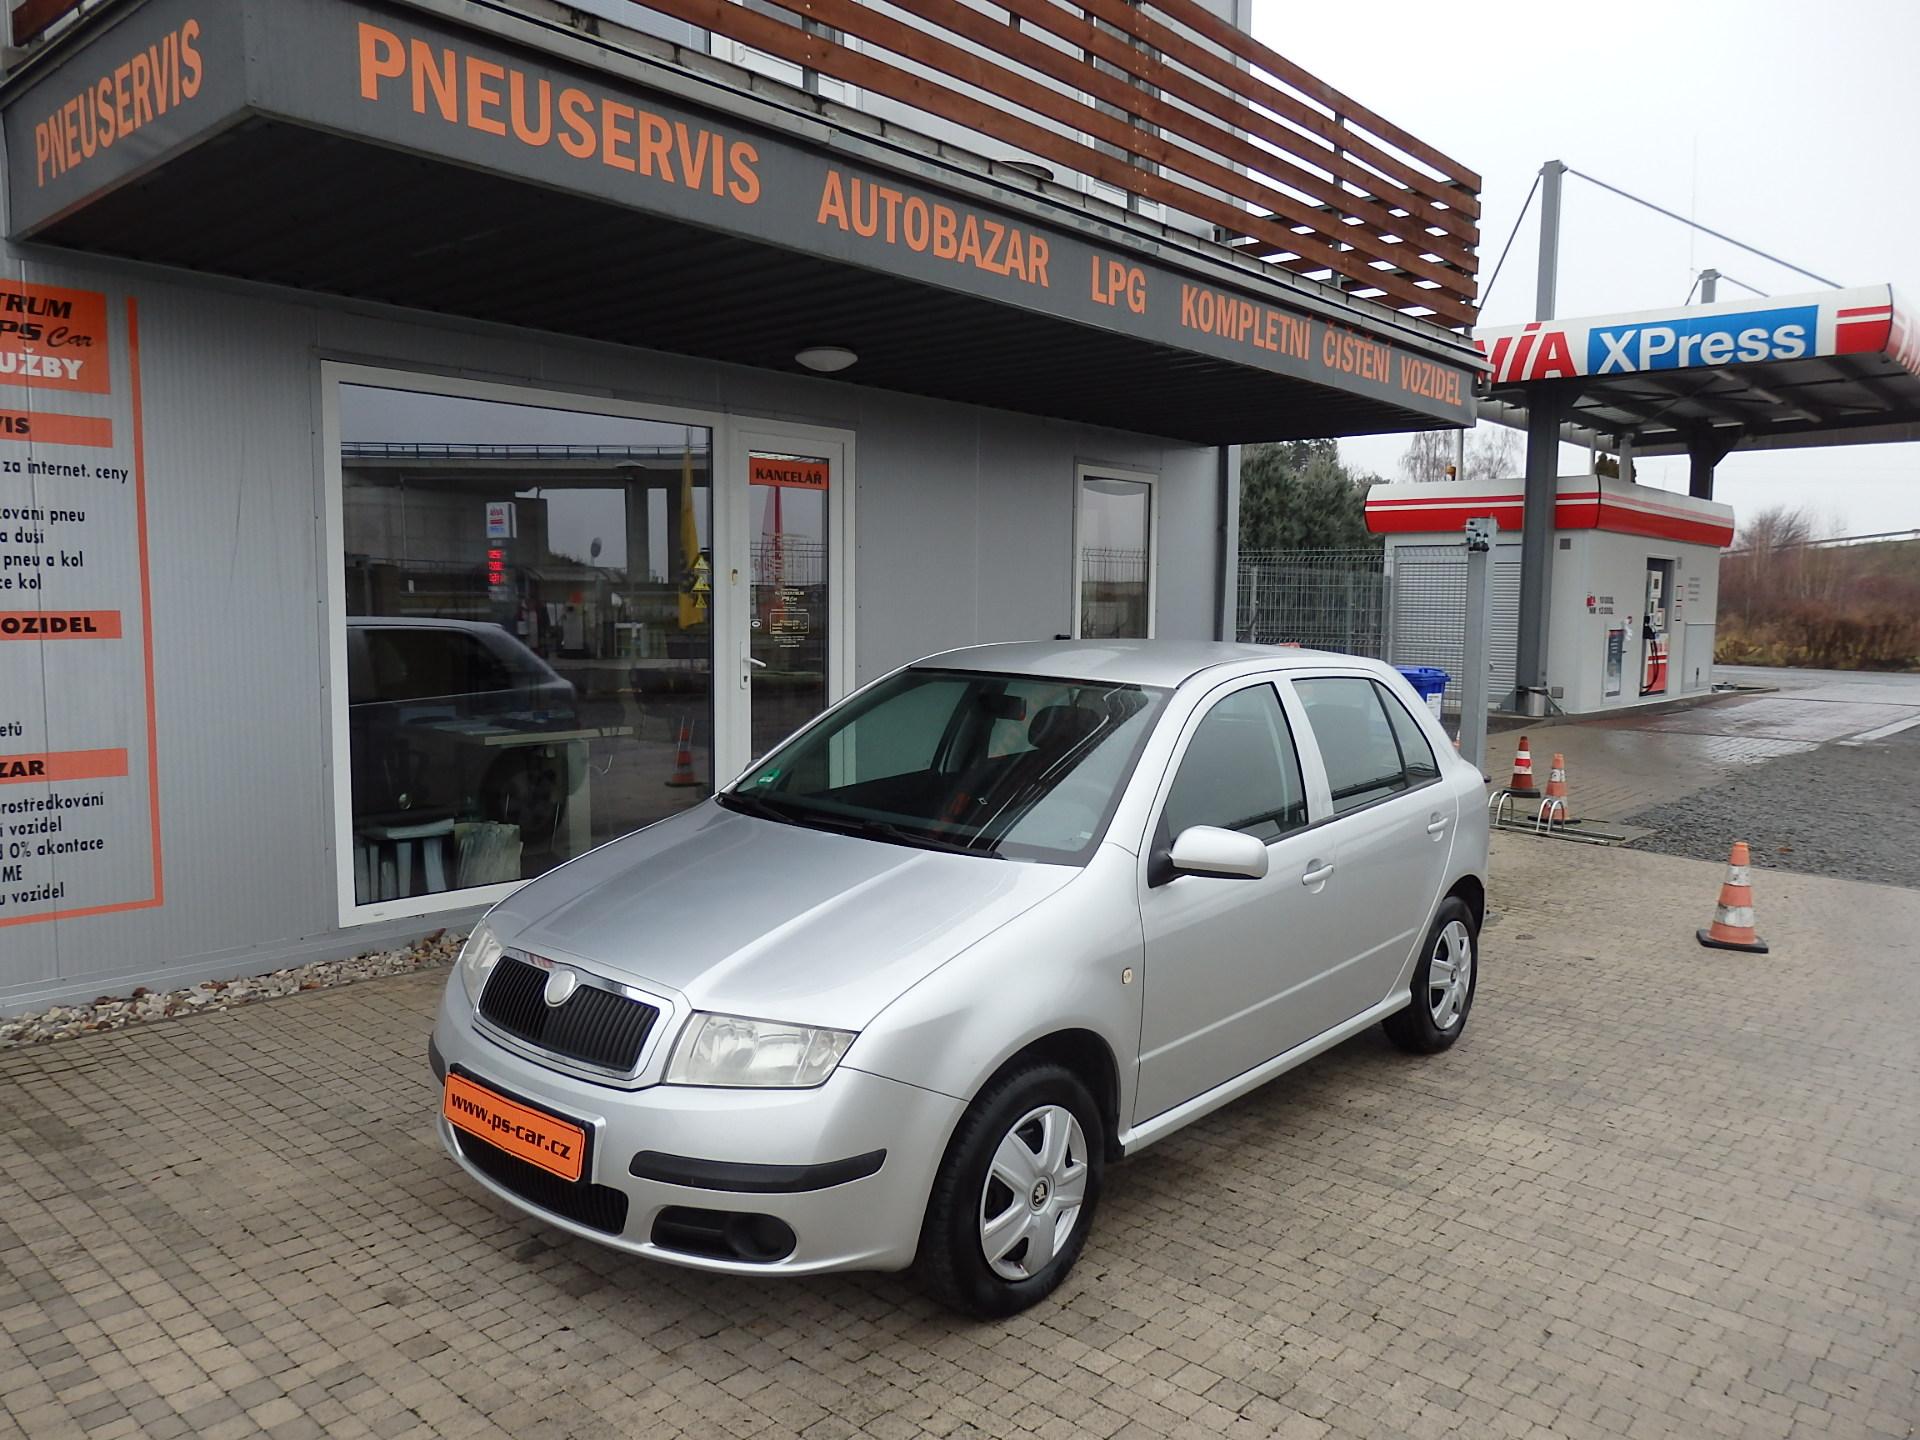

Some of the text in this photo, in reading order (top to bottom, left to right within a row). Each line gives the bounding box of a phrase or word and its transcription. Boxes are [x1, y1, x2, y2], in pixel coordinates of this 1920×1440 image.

[35, 18, 203, 188] PNEUSERVIS
[358, 22, 1463, 406] PNEUSERVIS AUTOBAZAR LPG KOMPLETNÍ ČIŠTĚNÍ VOZIDEL
[46, 326, 92, 347] Car
[0, 348, 84, 380] UŽBY
[1473, 323, 1808, 385] VIA XPress
[0, 415, 30, 434] IS
[3, 457, 129, 484] za internet. ceny
[755, 467, 823, 484] KANCELÁŘ
[0, 506, 85, 525] ování pneu
[4, 550, 84, 570] pneu a kol
[18, 572, 42, 590] kol
[1, 616, 97, 634] OZIDEL
[0, 791, 105, 814] rostředkování
[9, 815, 63, 836] vozidel
[9, 841, 32, 859] 0%
[37, 838, 105, 856] akontace
[12, 881, 65, 903] vozidel
[451, 1093, 571, 1160] www.ps-car.cz
